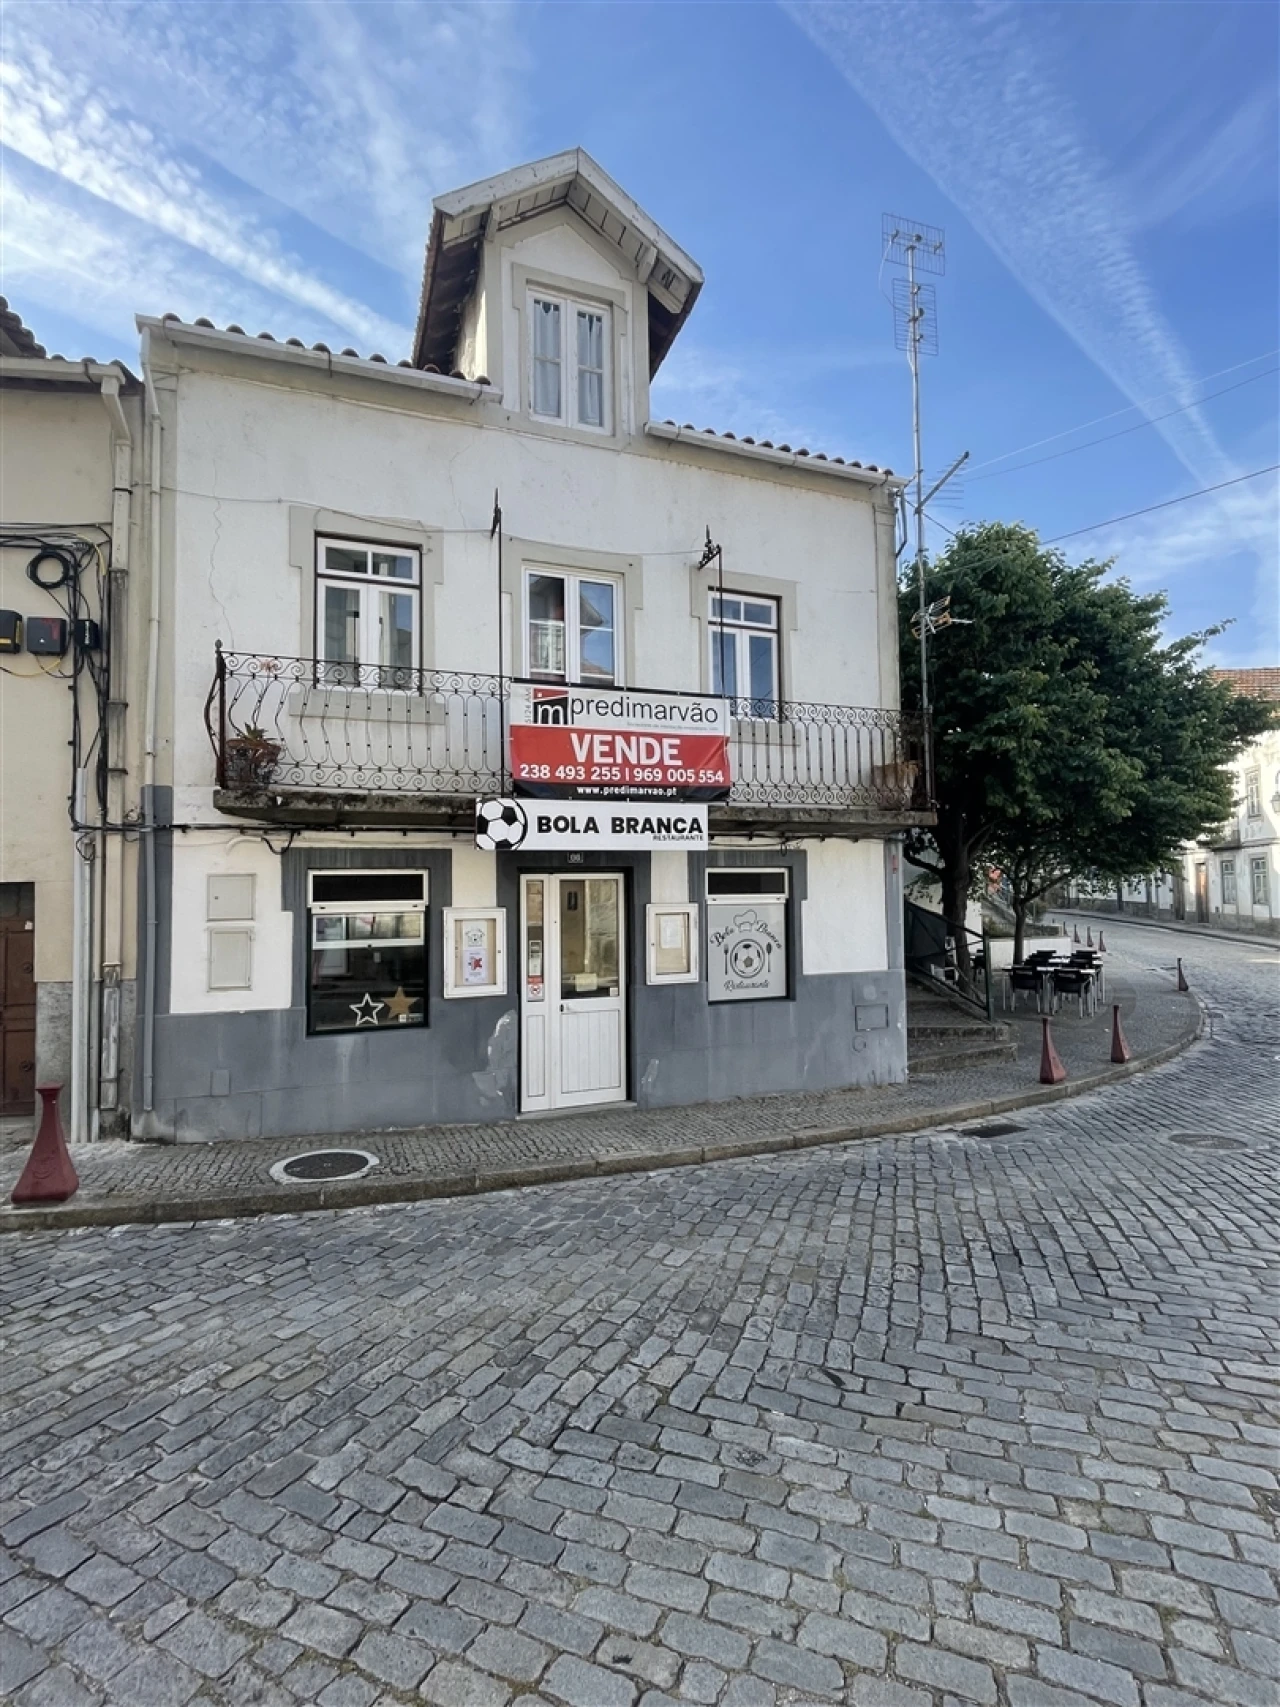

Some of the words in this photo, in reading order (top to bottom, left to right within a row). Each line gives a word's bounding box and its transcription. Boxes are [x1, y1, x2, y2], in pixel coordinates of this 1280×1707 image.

[571, 696, 718, 724] predimarvão
[570, 733, 683, 766] VENDE
[520, 764, 551, 779] 238
[555, 765, 586, 780] 493
[590, 766, 621, 780] 255
[633, 768, 663, 782] 969
[667, 769, 695, 783] 005
[698, 770, 724, 783] 554
[536, 816, 600, 834] BOLA
[611, 816, 704, 834] BRANCA
[652, 834, 704, 842] RESTAURANTE
